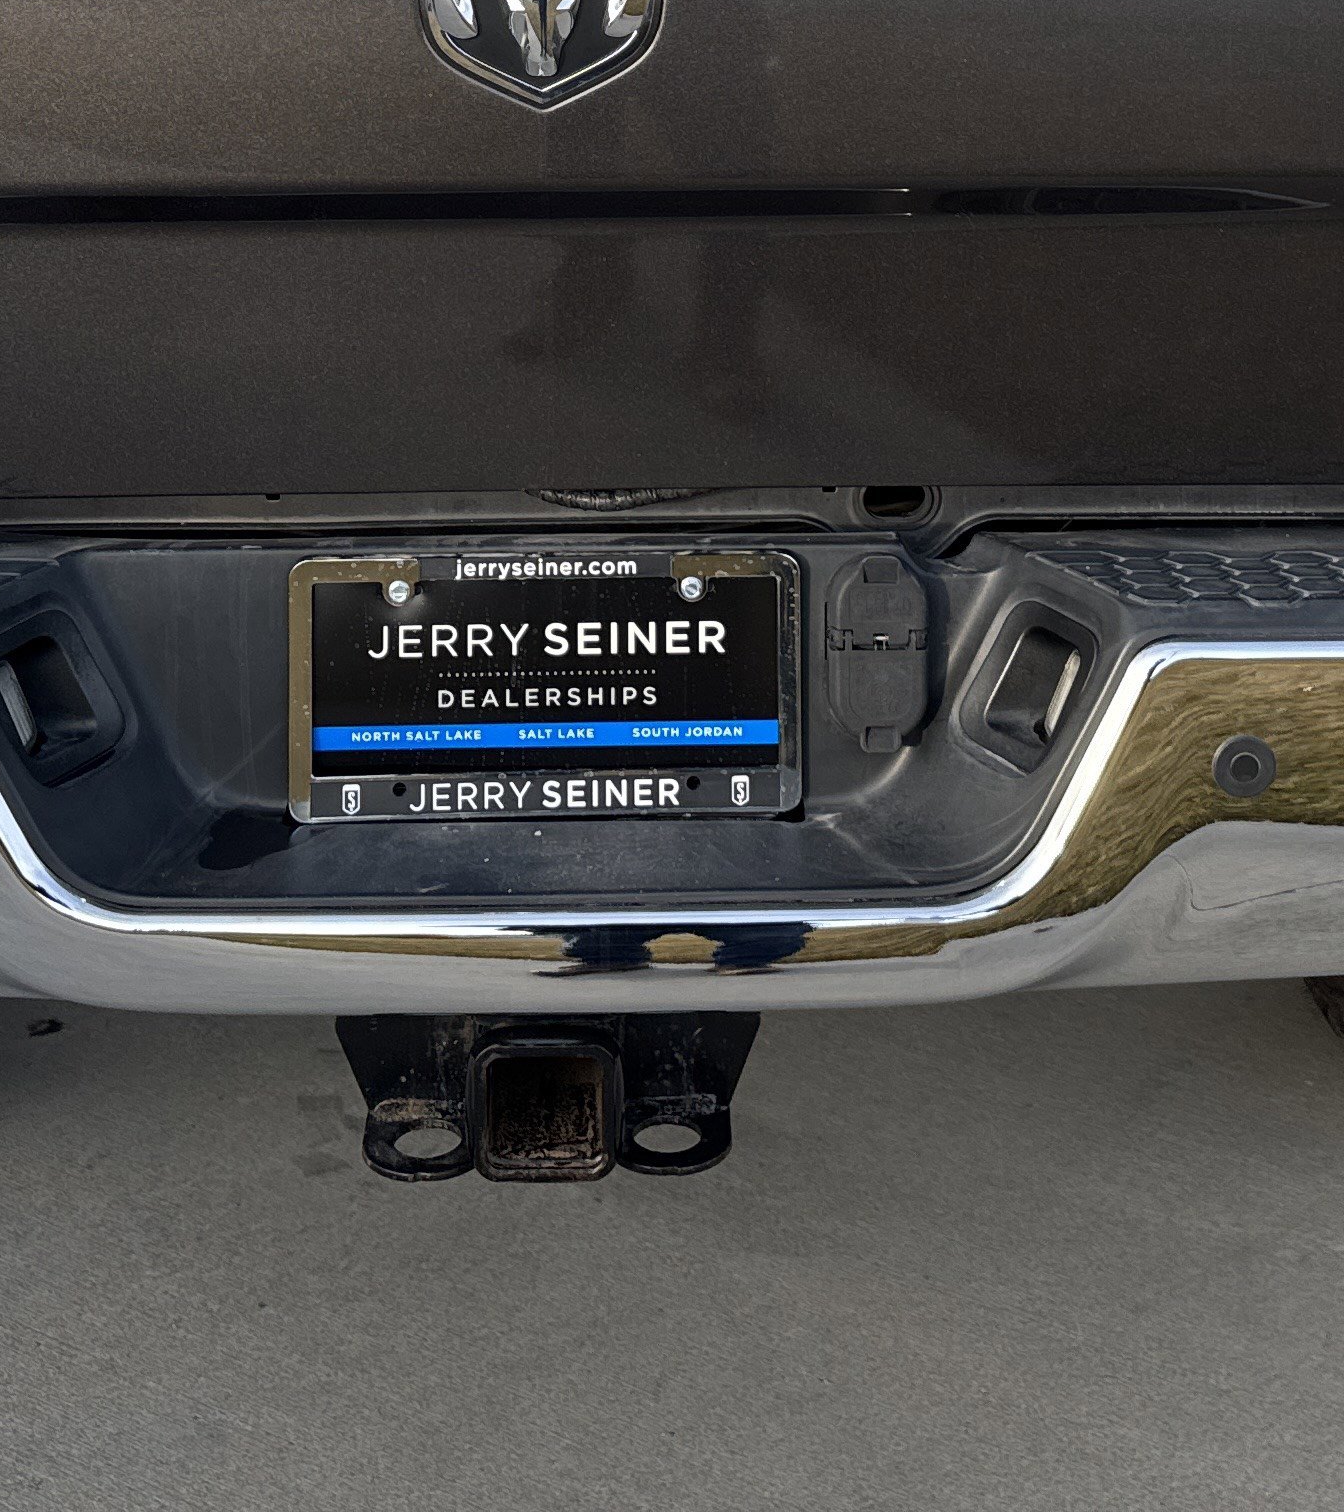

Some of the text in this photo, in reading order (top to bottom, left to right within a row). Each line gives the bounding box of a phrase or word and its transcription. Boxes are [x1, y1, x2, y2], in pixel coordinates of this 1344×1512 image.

[455, 557, 638, 580] jerryseiner.com
[367, 620, 727, 659] JERRY SEINER
[437, 686, 658, 709] DEALERSHIPS
[351, 729, 483, 743] NORTH SALT LAKE
[518, 728, 595, 740] SALT LAKE
[632, 726, 744, 738] SOUTH JORDAN
[409, 778, 680, 812] JERRY SEINER
